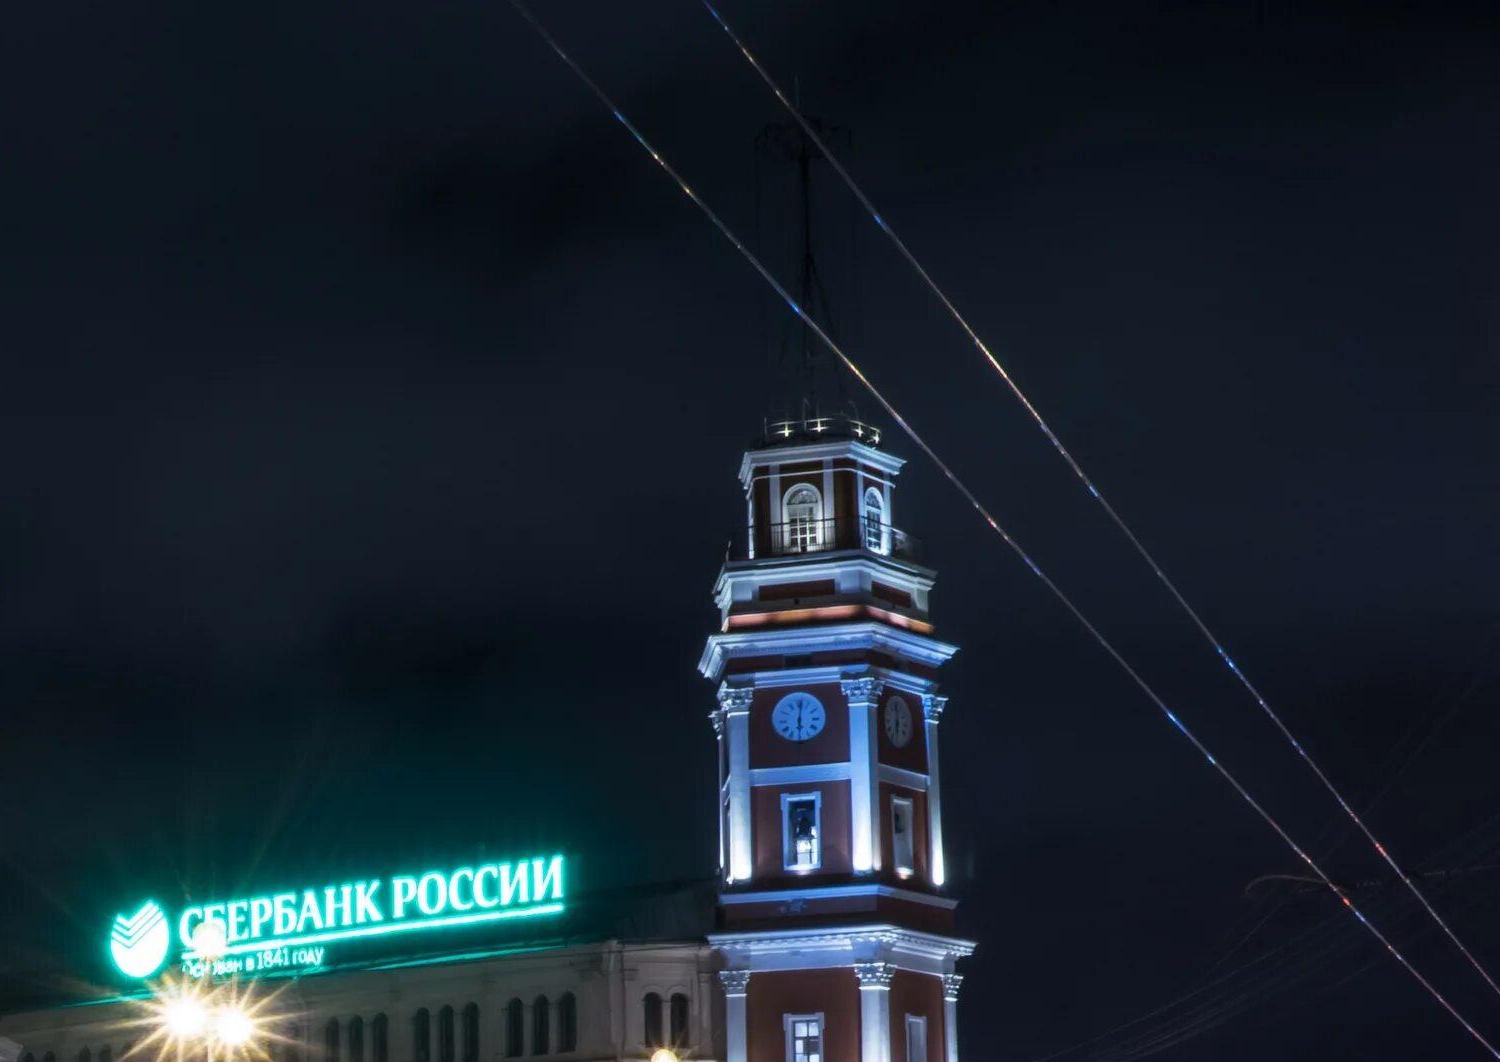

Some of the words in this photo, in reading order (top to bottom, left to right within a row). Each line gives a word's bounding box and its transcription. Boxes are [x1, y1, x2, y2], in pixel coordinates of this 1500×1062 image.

[179, 878, 384, 947] СБЕРБАНК
[391, 854, 565, 919] РОССИИ
[245, 957, 255, 972] в
[256, 947, 289, 970] 1841
[292, 946, 325, 966] году
